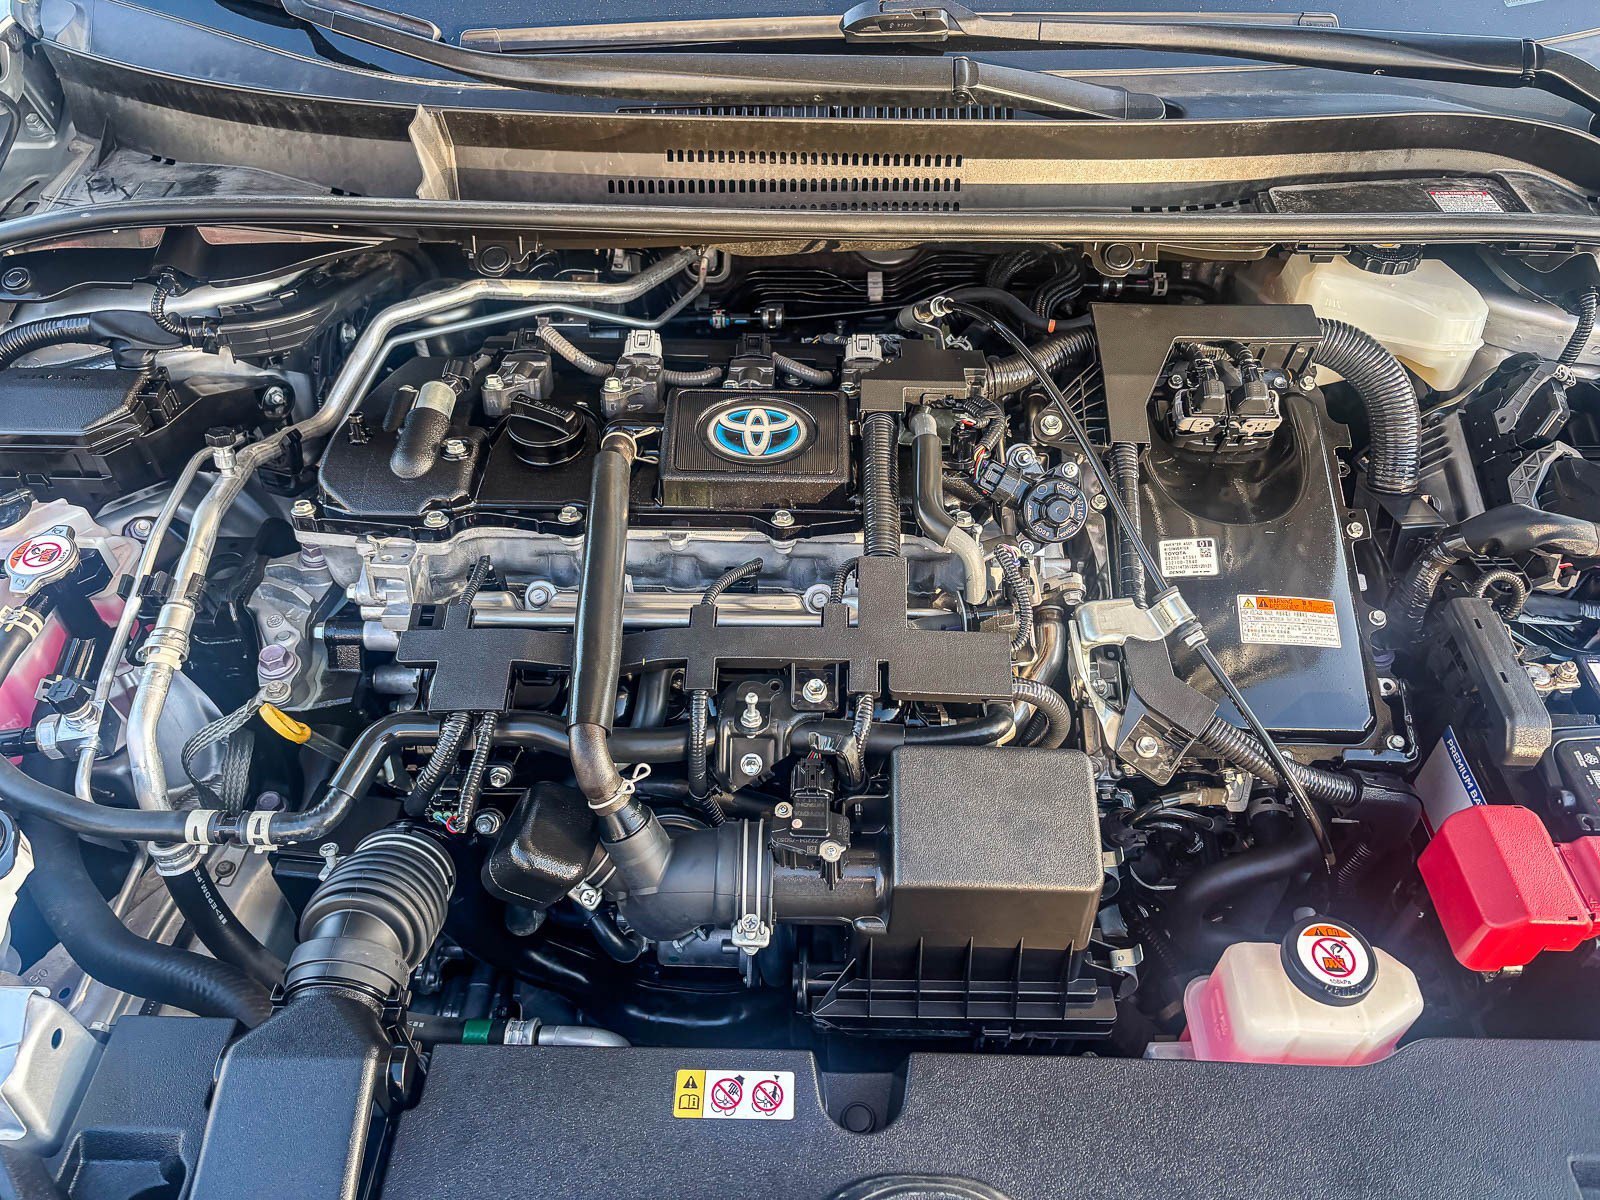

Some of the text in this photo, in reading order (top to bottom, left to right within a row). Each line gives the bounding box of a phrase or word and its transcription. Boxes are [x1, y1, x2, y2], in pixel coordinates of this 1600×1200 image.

[1058, 482, 1077, 496] 25620
[1446, 738, 1484, 805] PREMIUM BA
